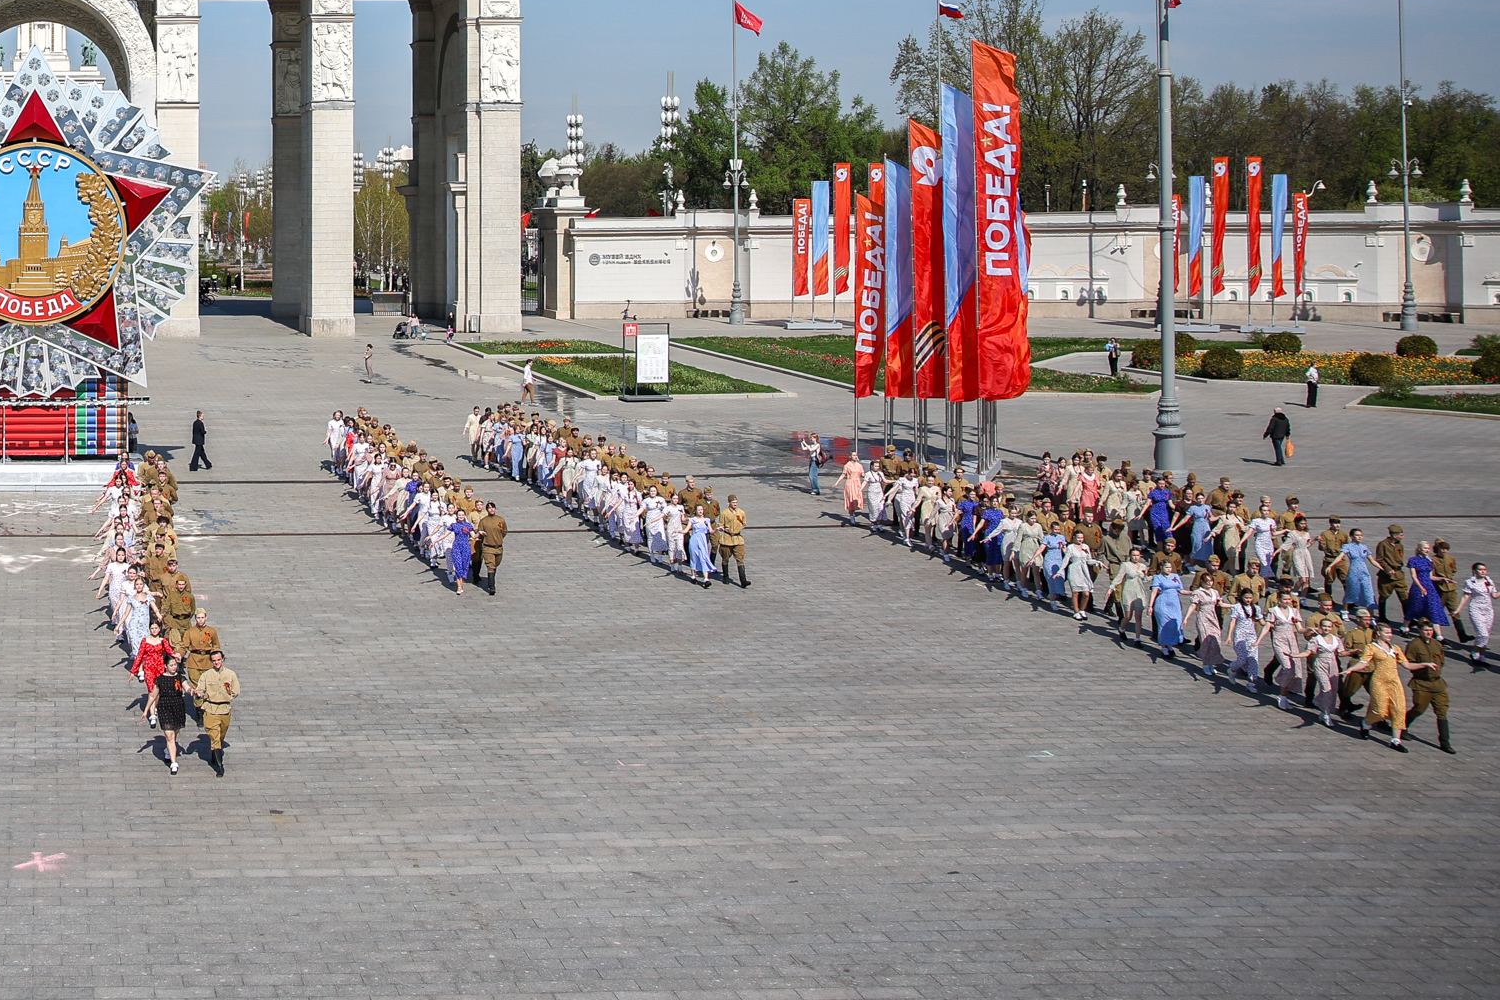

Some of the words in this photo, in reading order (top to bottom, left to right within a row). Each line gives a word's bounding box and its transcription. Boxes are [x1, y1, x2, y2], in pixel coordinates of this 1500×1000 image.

[835, 168, 848, 182] 9
[870, 168, 882, 182] 9
[1214, 162, 1227, 177] 9
[1248, 161, 1261, 177] 9
[982, 102, 1017, 277] ПОБЕДА!
[797, 203, 810, 255] ПОБЕДА!
[855, 211, 886, 354] ПОБЕДА!
